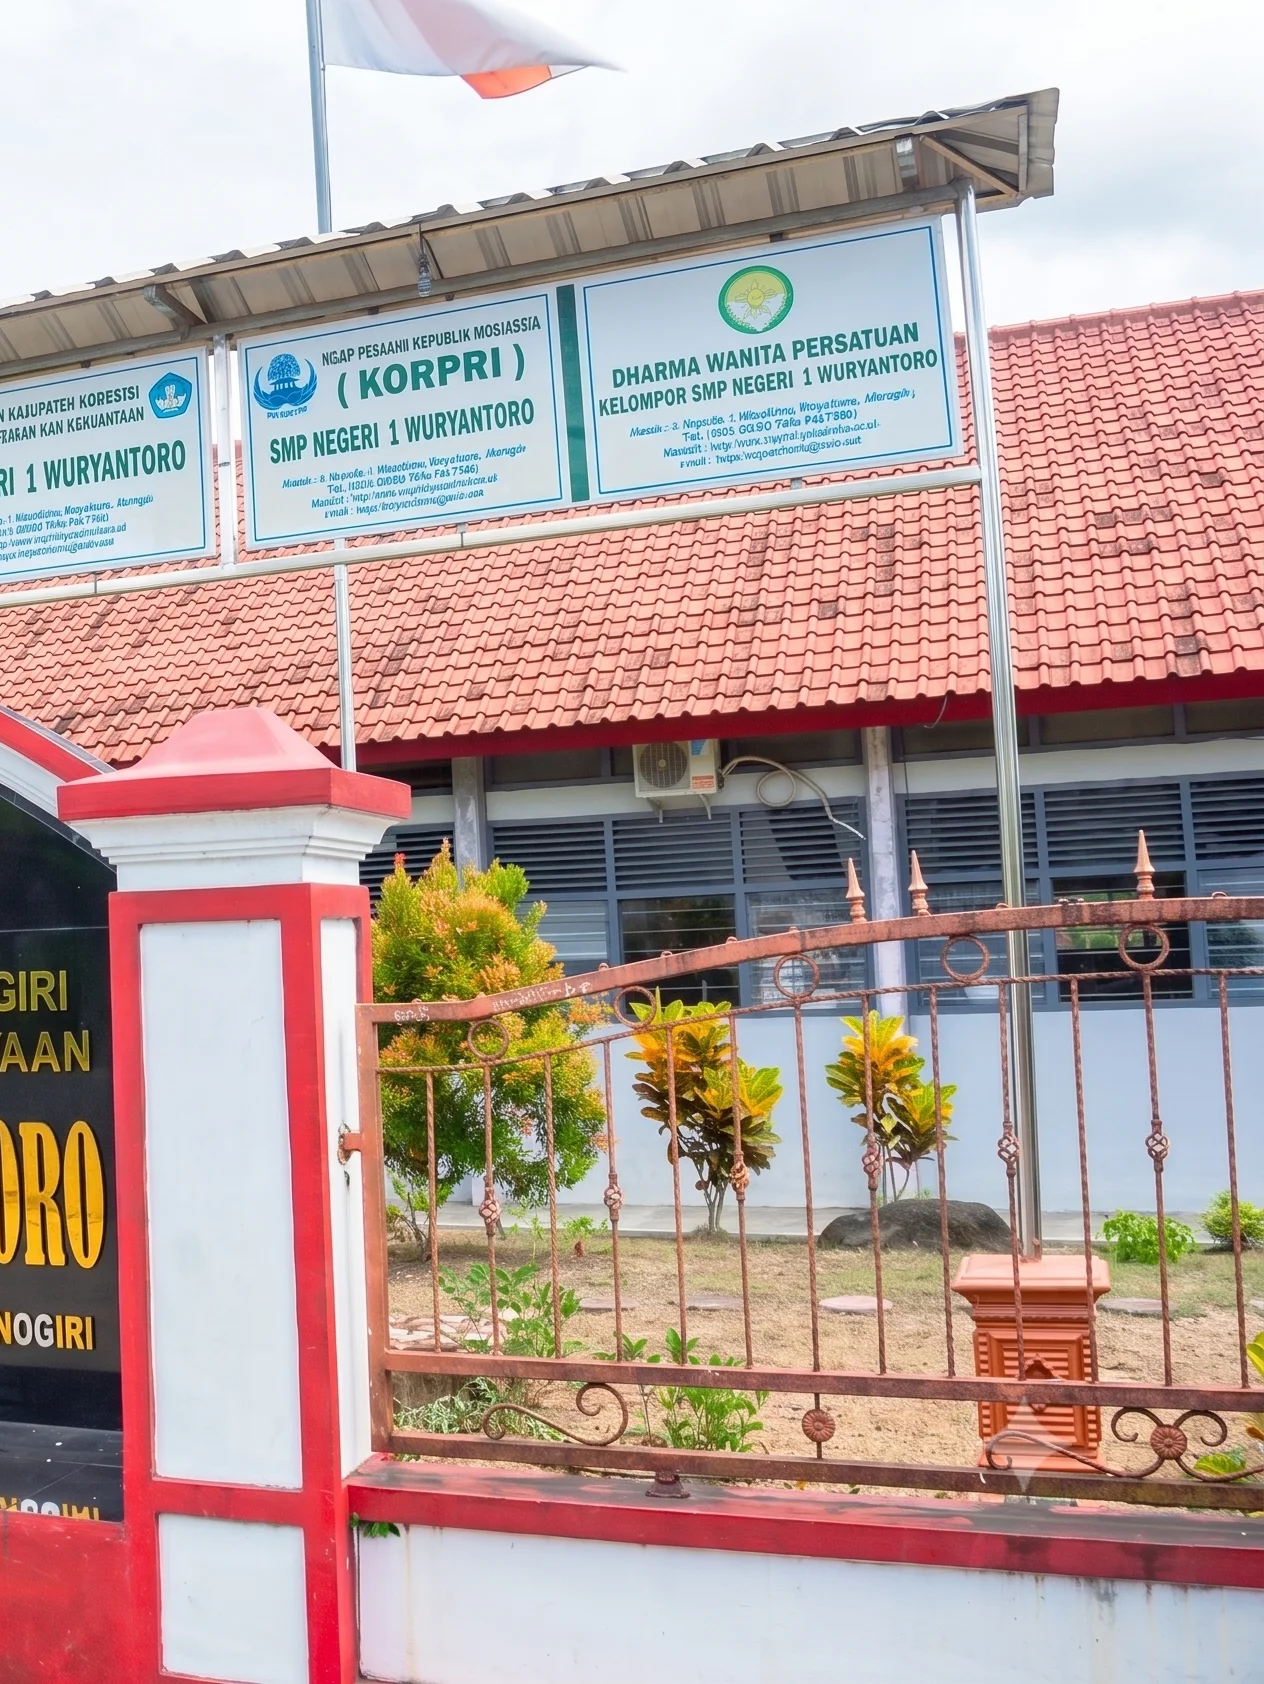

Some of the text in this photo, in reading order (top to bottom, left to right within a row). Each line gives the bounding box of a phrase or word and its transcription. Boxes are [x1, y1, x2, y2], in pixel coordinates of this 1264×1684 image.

[412, 328, 471, 351] KEPUBLIK
[612, 322, 919, 388] DHARMA WANITA PERSATUAN
[358, 346, 502, 401] KORPRI
[599, 348, 938, 417] KELOMPOR SMP NEGERI 1 WURYANTORO
[40, 419, 64, 438] KAN
[270, 398, 536, 464] SMP NEGERI 1 WURYANTORO
[26, 463, 37, 494] 1
[43, 439, 187, 491] WURYANTORO
